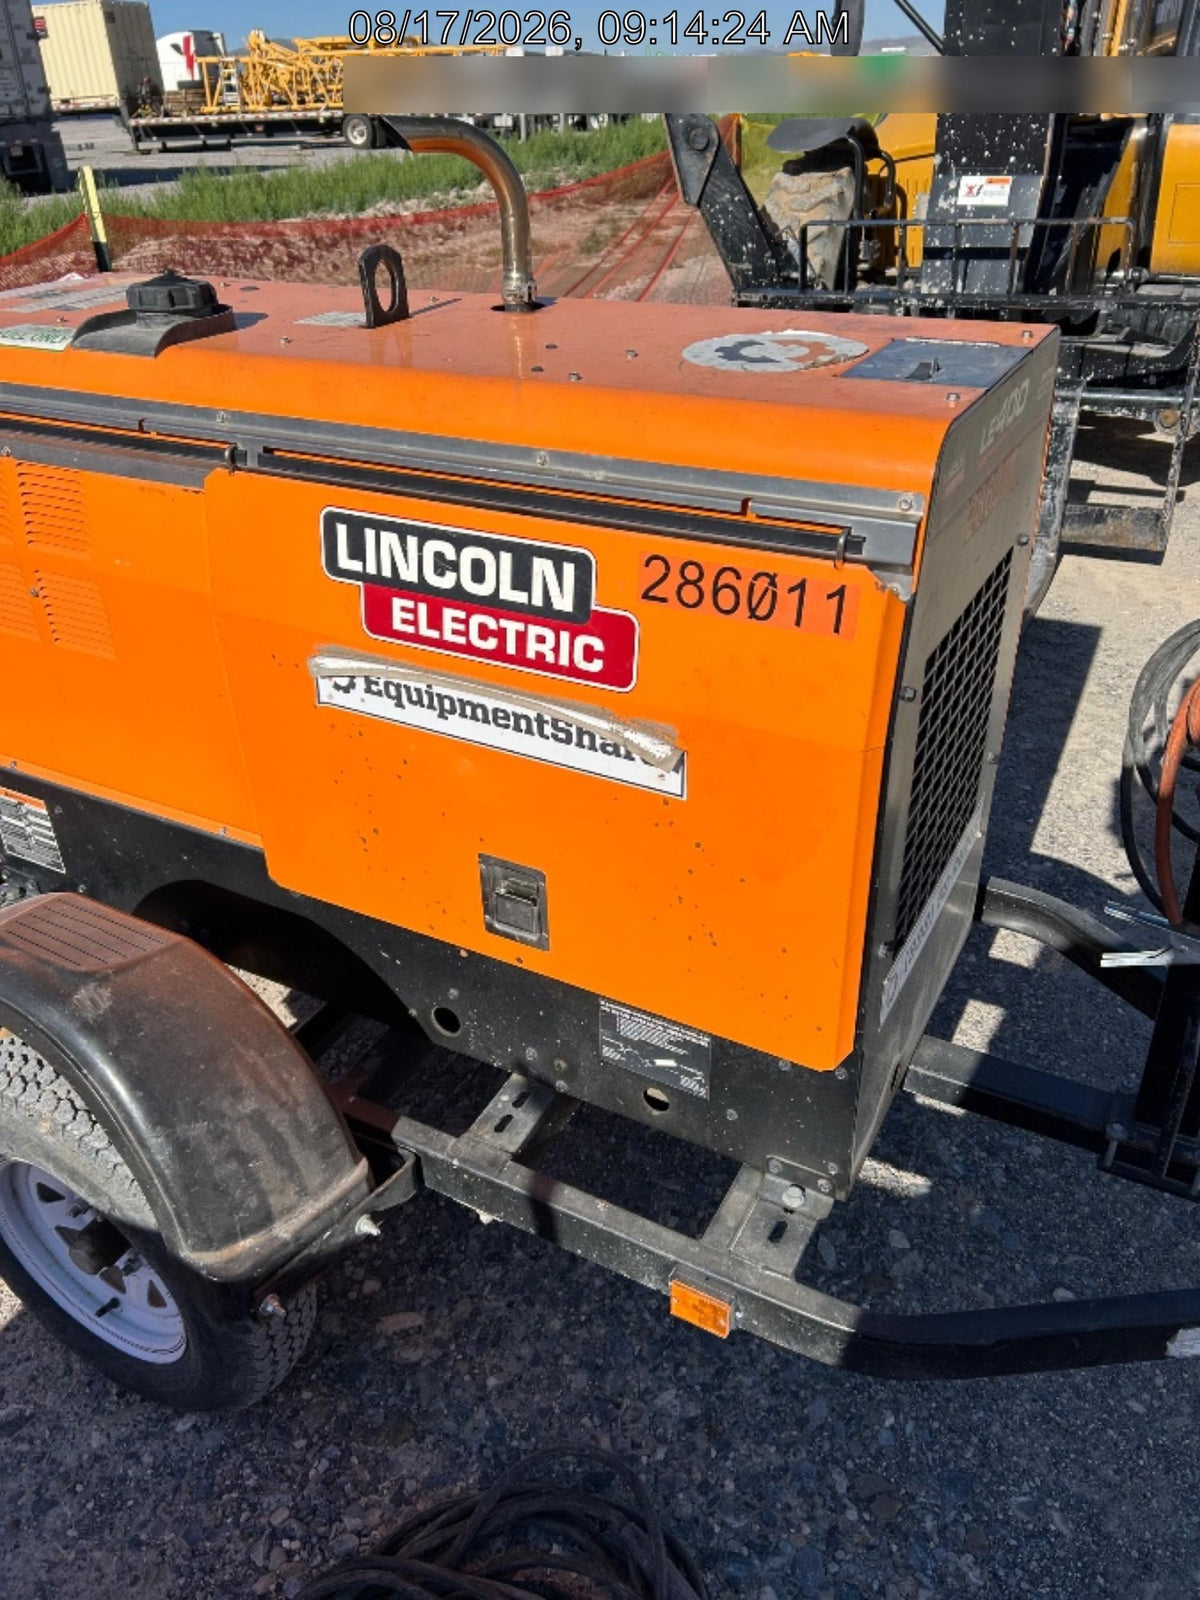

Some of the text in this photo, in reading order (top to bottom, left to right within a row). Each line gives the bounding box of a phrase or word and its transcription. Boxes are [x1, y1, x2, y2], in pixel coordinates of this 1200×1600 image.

[335, 522, 576, 613] LINCOLN
[641, 554, 847, 635] 286011
[391, 596, 606, 674] ELECTRIC
